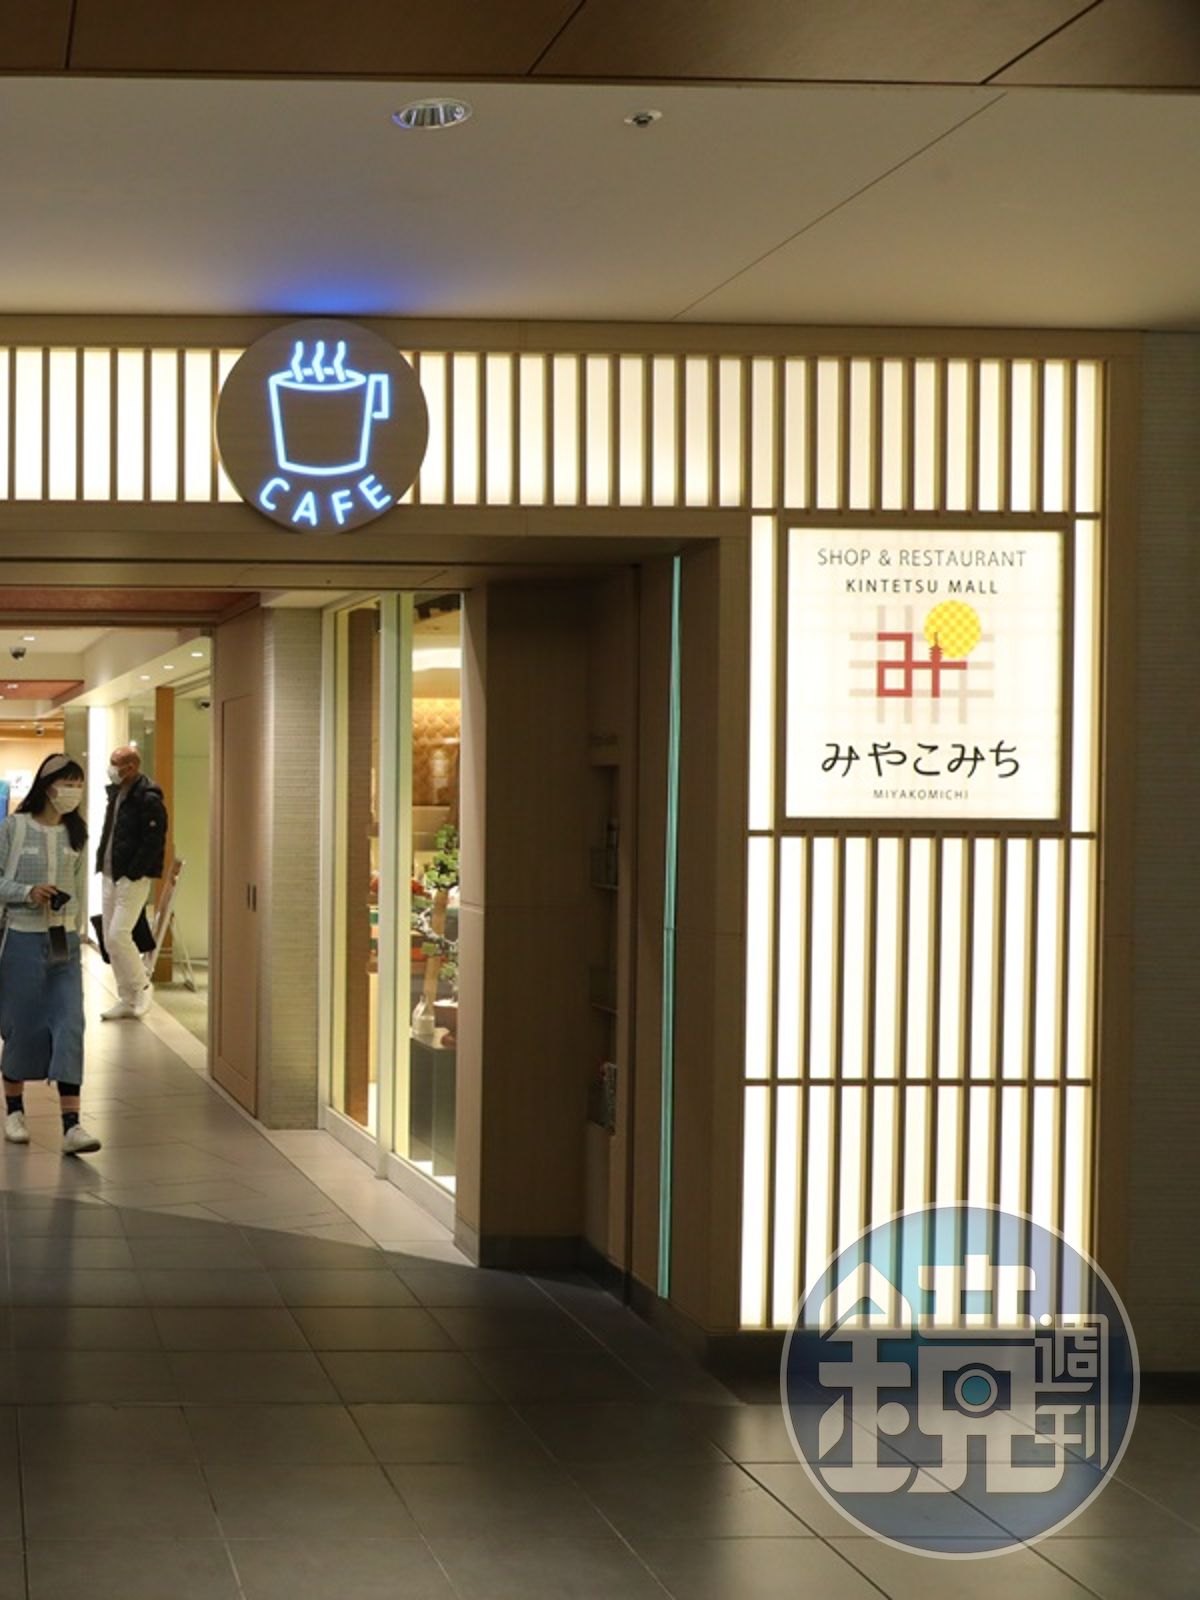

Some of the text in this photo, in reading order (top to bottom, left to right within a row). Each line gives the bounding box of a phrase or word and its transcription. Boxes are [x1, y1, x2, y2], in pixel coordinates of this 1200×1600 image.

[259, 474, 392, 526] CAFE
[817, 548, 1026, 567] SHOP & RESTAURANT
[846, 579, 998, 594] KINTETSU MALL
[821, 740, 1019, 779] みやこみち
[873, 789, 969, 800] MIYAKOMICHI
